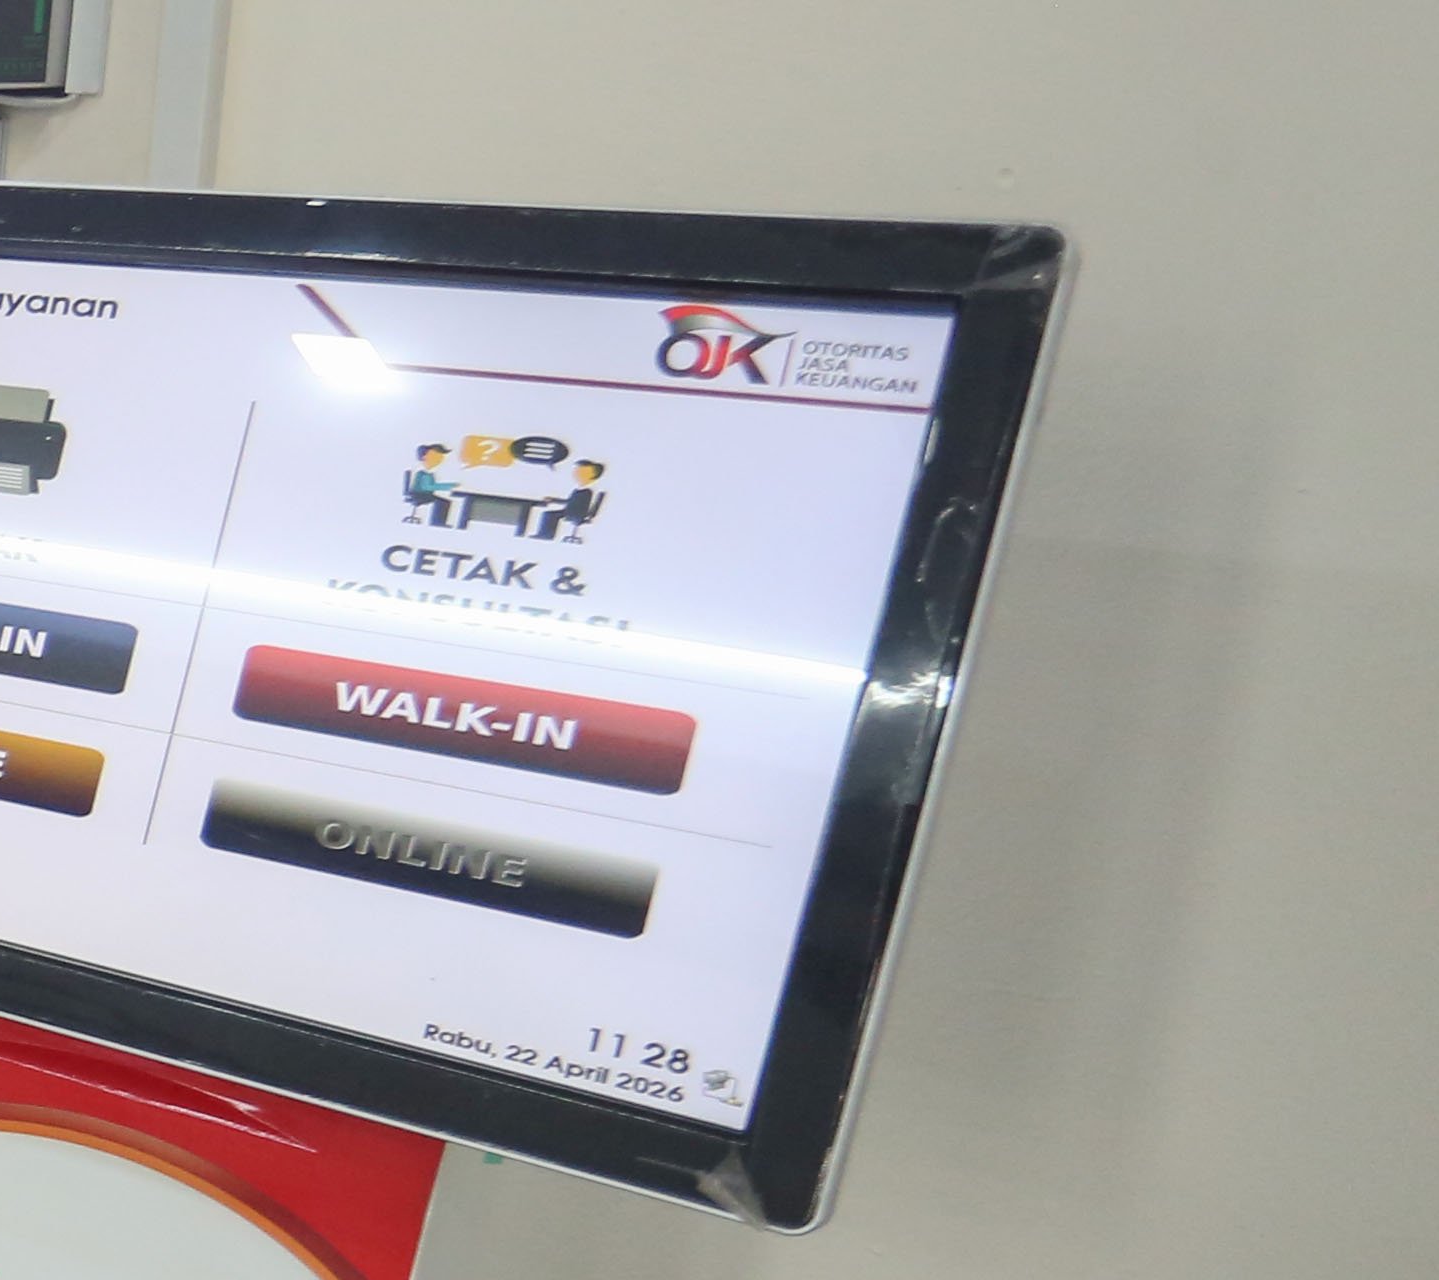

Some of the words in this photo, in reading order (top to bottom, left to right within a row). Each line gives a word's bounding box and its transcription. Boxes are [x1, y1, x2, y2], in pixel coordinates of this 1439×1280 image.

[655, 331, 780, 385] OJK
[798, 357, 848, 372] JASA
[802, 340, 909, 361] OTORITAS
[795, 371, 920, 394] KEUANGAN
[382, 544, 538, 589] CETAK
[550, 567, 587, 597] &
[336, 681, 579, 751] WALK-IN
[315, 821, 529, 888] ONLINE
[423, 1024, 497, 1058] Rabu,
[504, 1044, 538, 1066] 22
[544, 1055, 609, 1085] April
[615, 1072, 685, 1104] 2026
[588, 1027, 627, 1059] 11
[640, 1042, 691, 1074] 28
